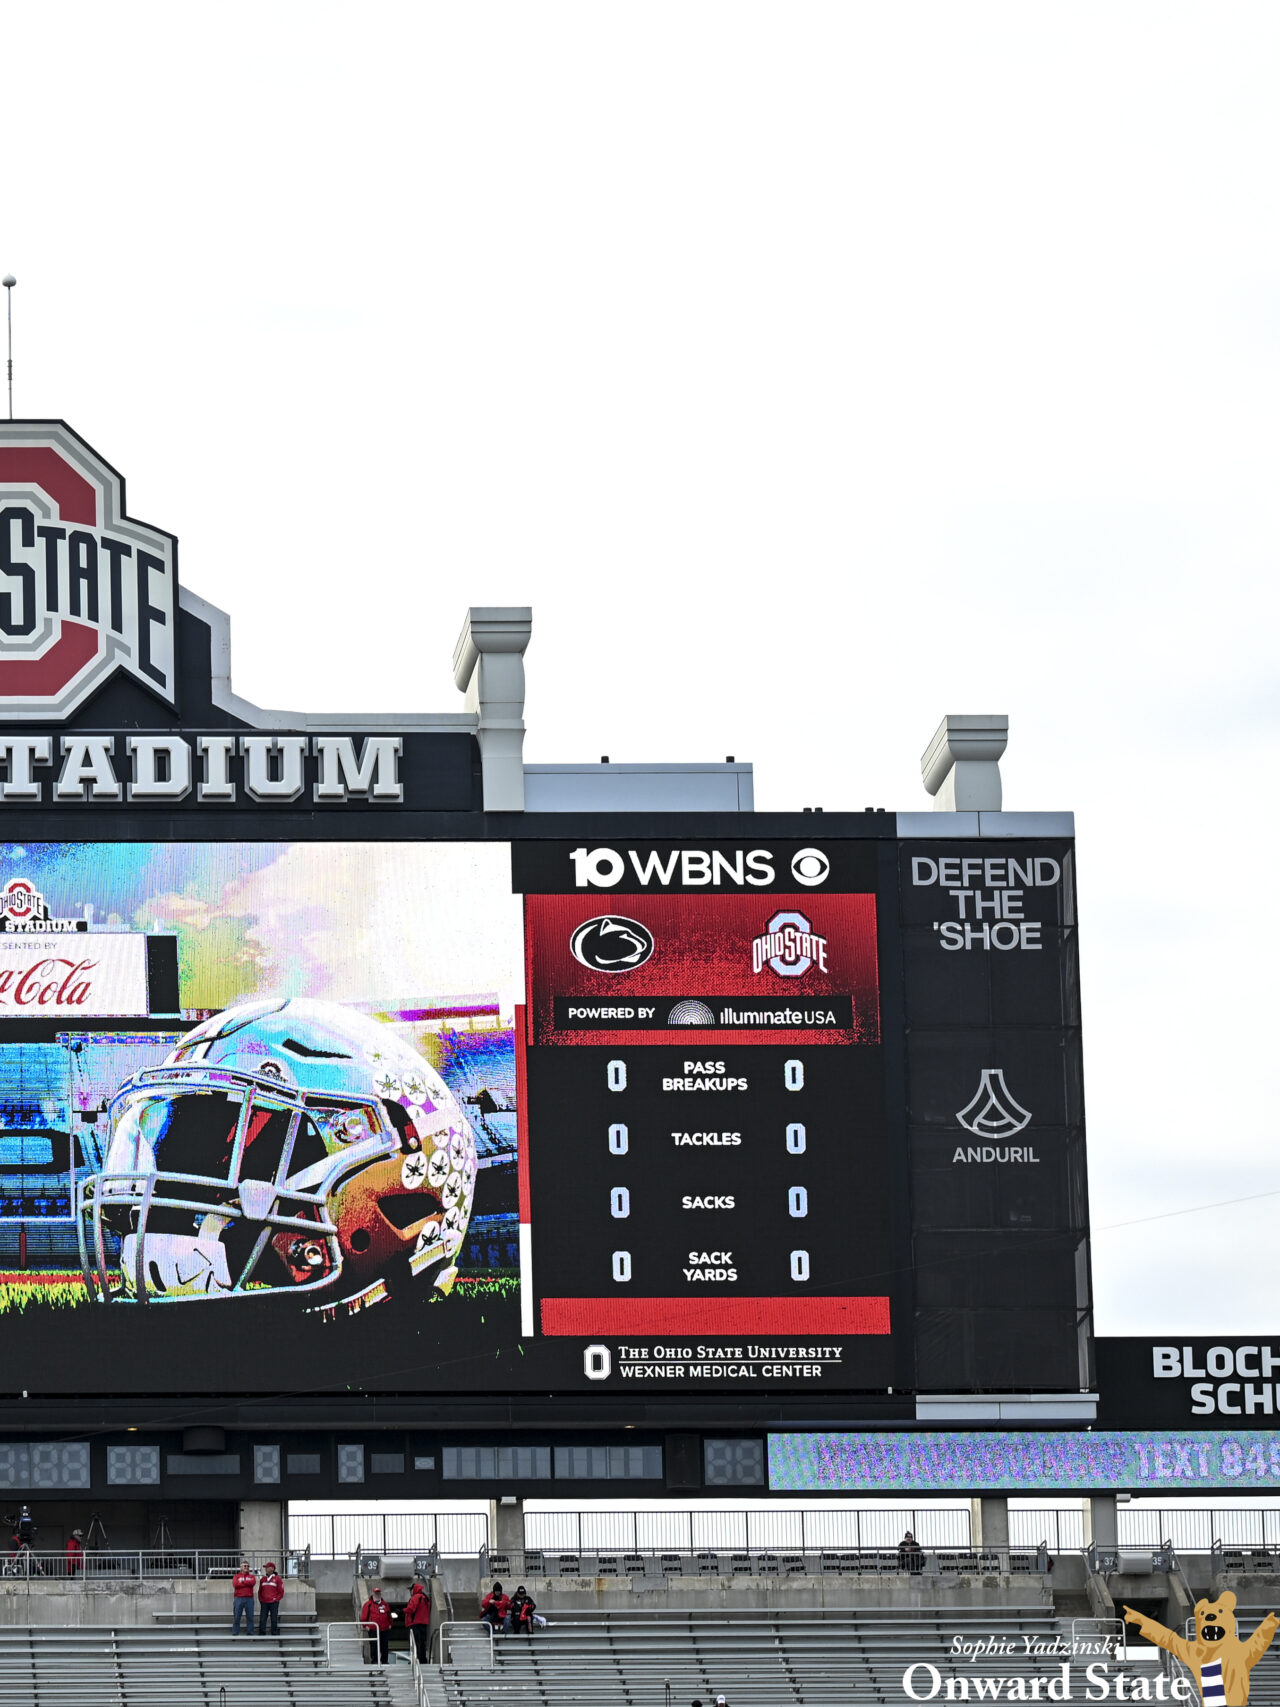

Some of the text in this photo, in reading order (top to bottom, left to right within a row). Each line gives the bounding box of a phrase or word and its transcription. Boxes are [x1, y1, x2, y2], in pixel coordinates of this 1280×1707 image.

[570, 848, 775, 887] 10 WBNS
[911, 857, 1061, 887] DEFEND
[949, 890, 1025, 919] THE
[5, 920, 78, 932] STADIUM
[934, 921, 1042, 950] 'SHOE
[45, 942, 58, 950] BY
[568, 1008, 655, 1018] POWERED BY
[720, 1008, 836, 1024] illuminate USA
[607, 1060, 627, 1091] 0
[684, 1062, 725, 1074] PASS
[784, 1060, 804, 1091] 0
[663, 1078, 747, 1091] BREAKUPS
[608, 1124, 628, 1154] 0
[671, 1133, 741, 1145] TACKLES
[786, 1123, 806, 1154] 0
[952, 1147, 1040, 1163] ANDURIL
[610, 1187, 630, 1218] 0
[682, 1196, 735, 1208] SACKS
[788, 1187, 808, 1218] 0
[612, 1251, 632, 1281] 0
[689, 1252, 733, 1264] SACK
[790, 1250, 810, 1281] 0
[683, 1269, 738, 1281] YARDS
[620, 1365, 822, 1378] WEXNER MEDICAL CENTER
[1152, 1345, 1280, 1378] BLOCH
[1190, 1382, 1280, 1415] SCH
[1134, 1441, 1213, 1479] TEXT
